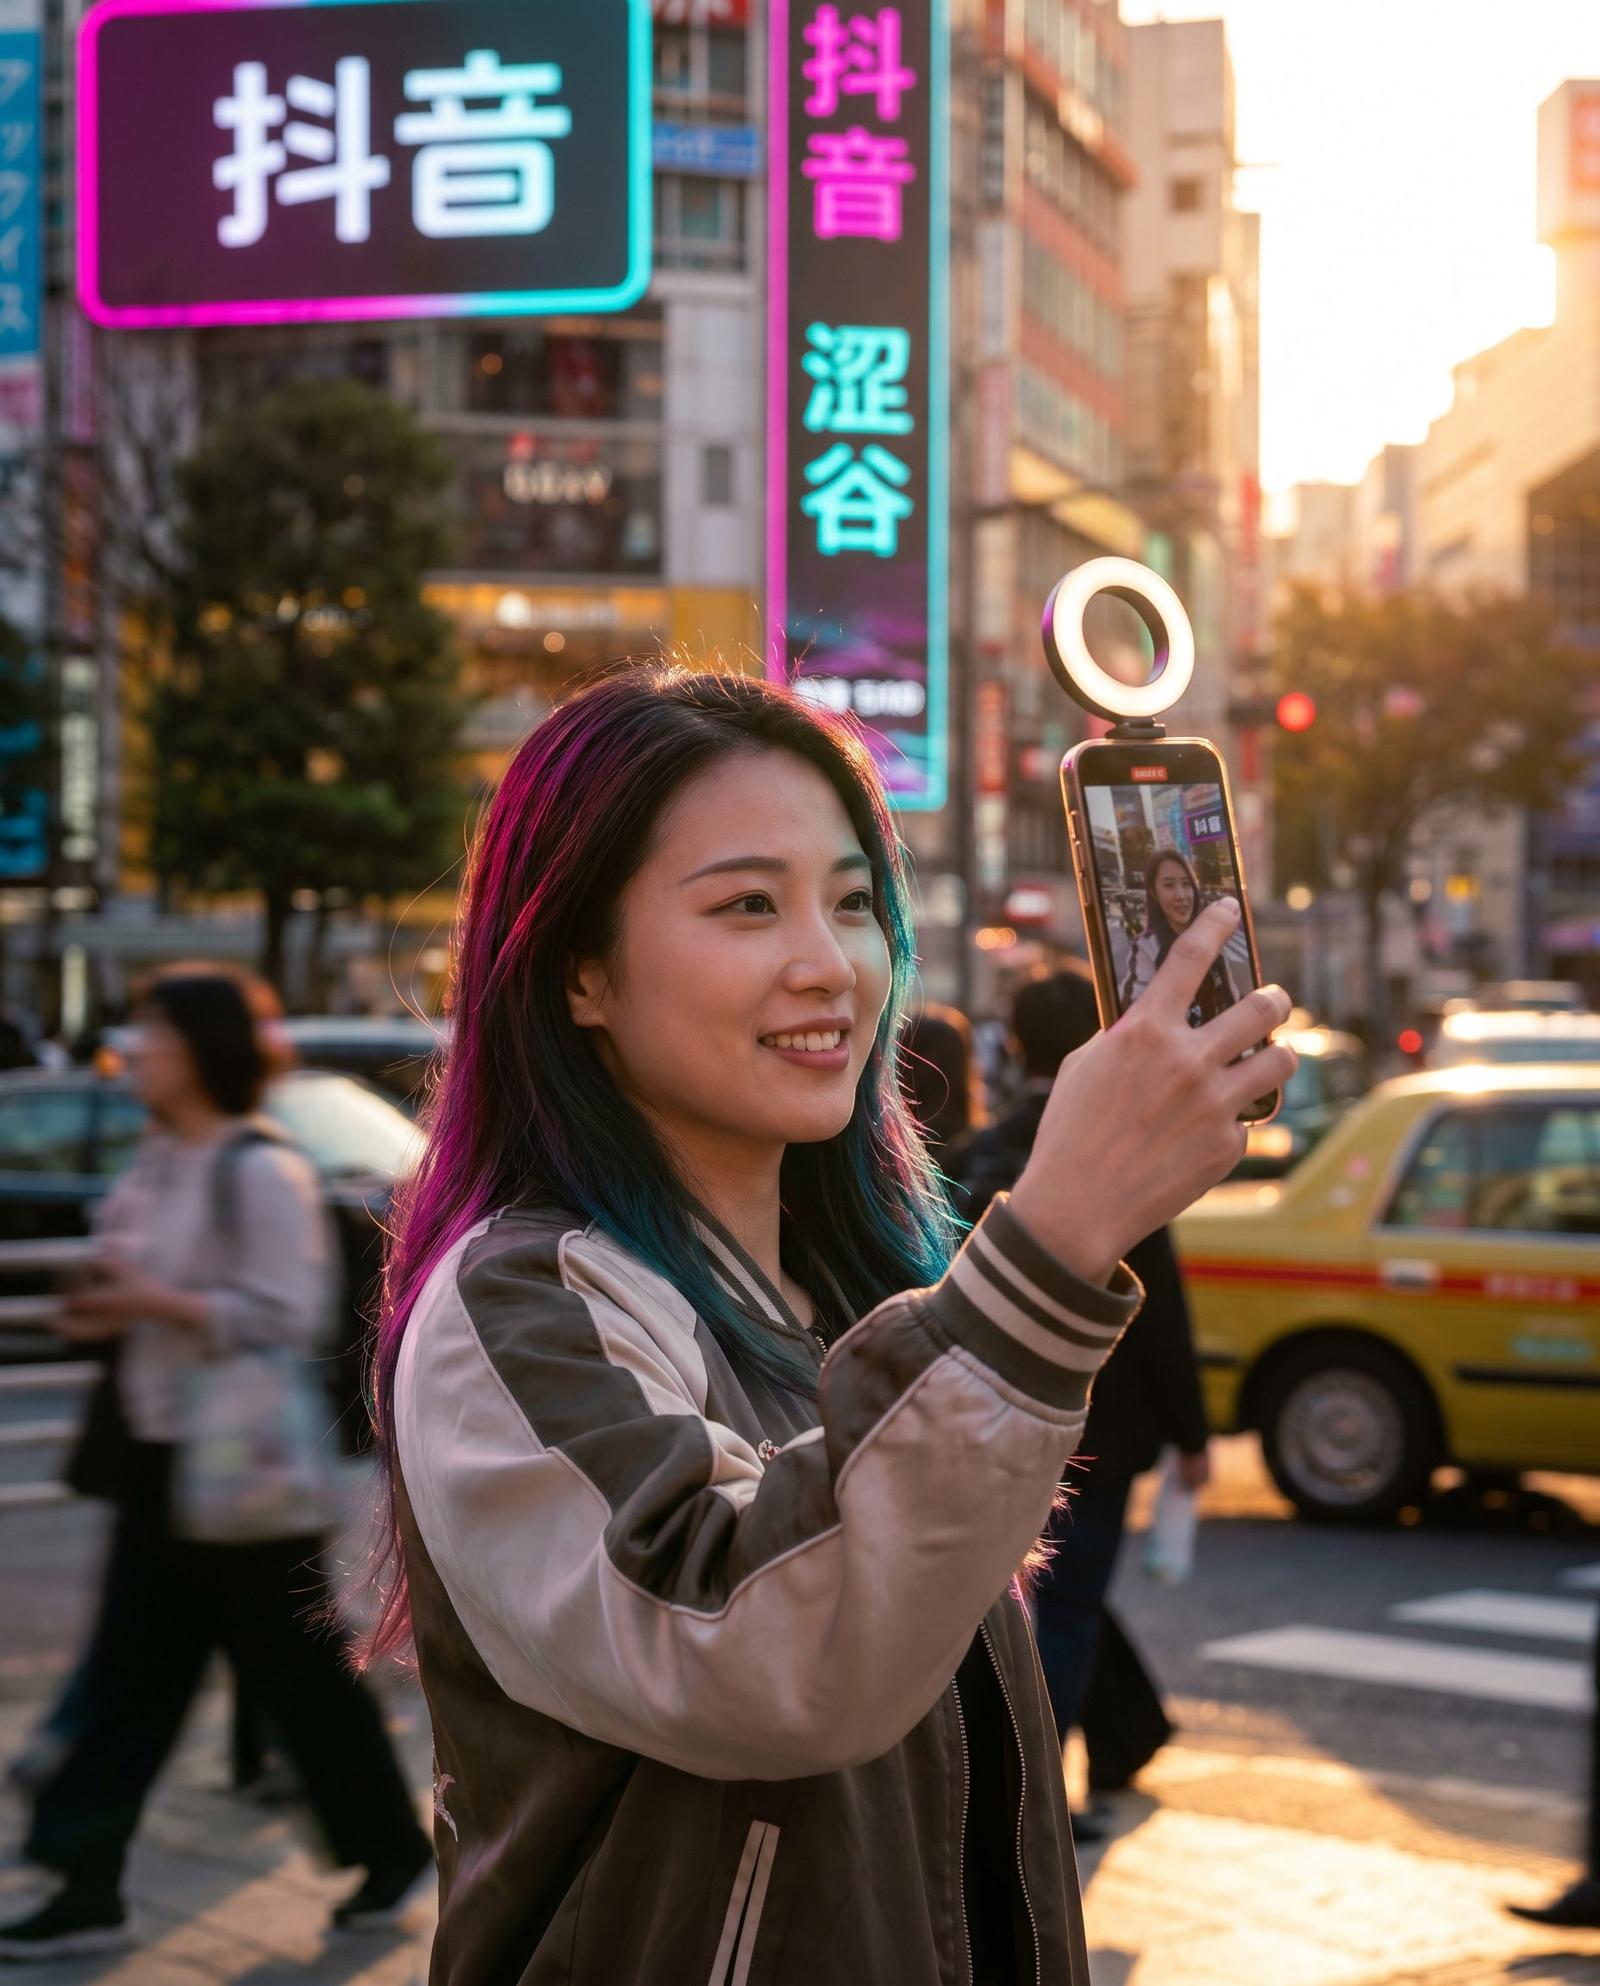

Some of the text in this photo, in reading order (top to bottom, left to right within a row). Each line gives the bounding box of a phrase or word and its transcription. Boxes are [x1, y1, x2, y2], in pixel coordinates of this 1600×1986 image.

[213, 50, 572, 247] 抖音
[802, 4, 916, 242] 抖音
[801, 321, 915, 558] 涩谷
